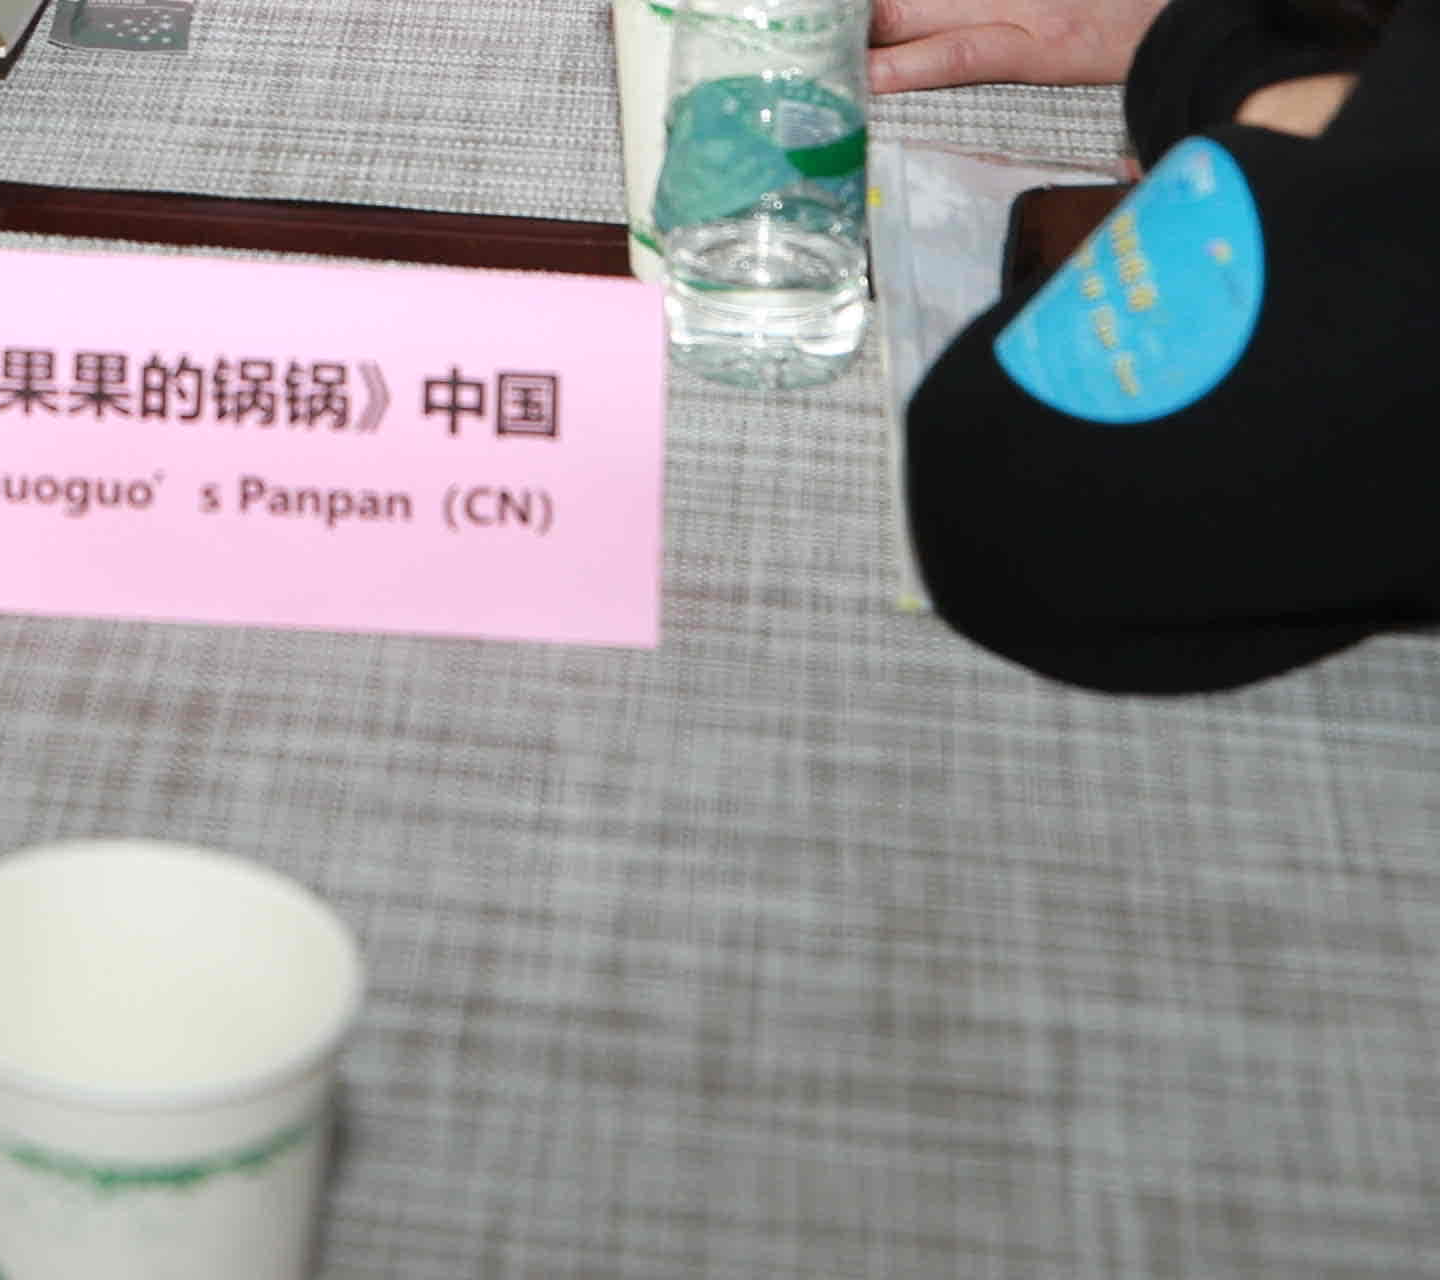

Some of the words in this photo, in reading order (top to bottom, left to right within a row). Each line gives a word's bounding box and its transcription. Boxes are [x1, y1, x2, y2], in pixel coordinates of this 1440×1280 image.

[421, 366, 560, 440] 中国
[237, 474, 414, 529] Panpan
[440, 485, 554, 536] (CN)
